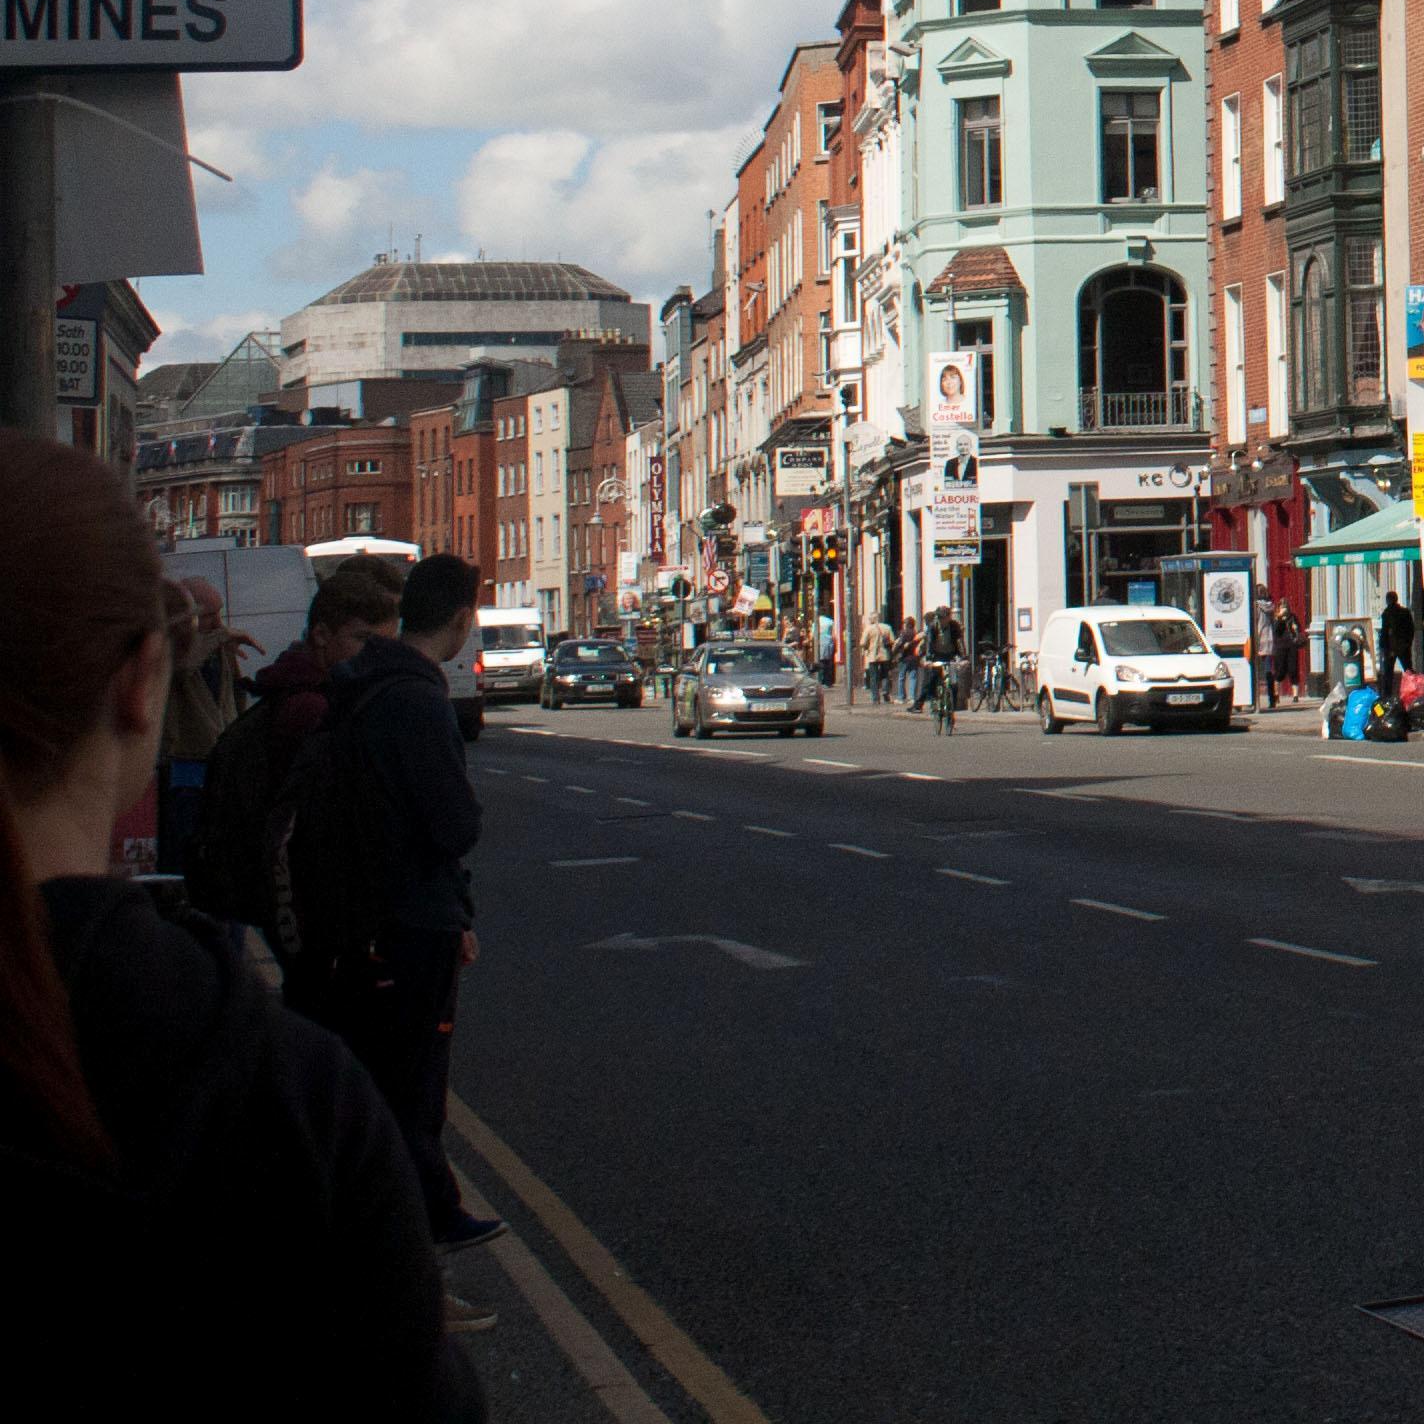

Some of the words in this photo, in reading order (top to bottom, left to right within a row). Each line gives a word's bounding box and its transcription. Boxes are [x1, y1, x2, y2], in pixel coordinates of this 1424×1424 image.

[932, 411, 973, 422] Costello
[934, 495, 979, 504] LABOUR:
[650, 462, 664, 553] OLYMPIA
